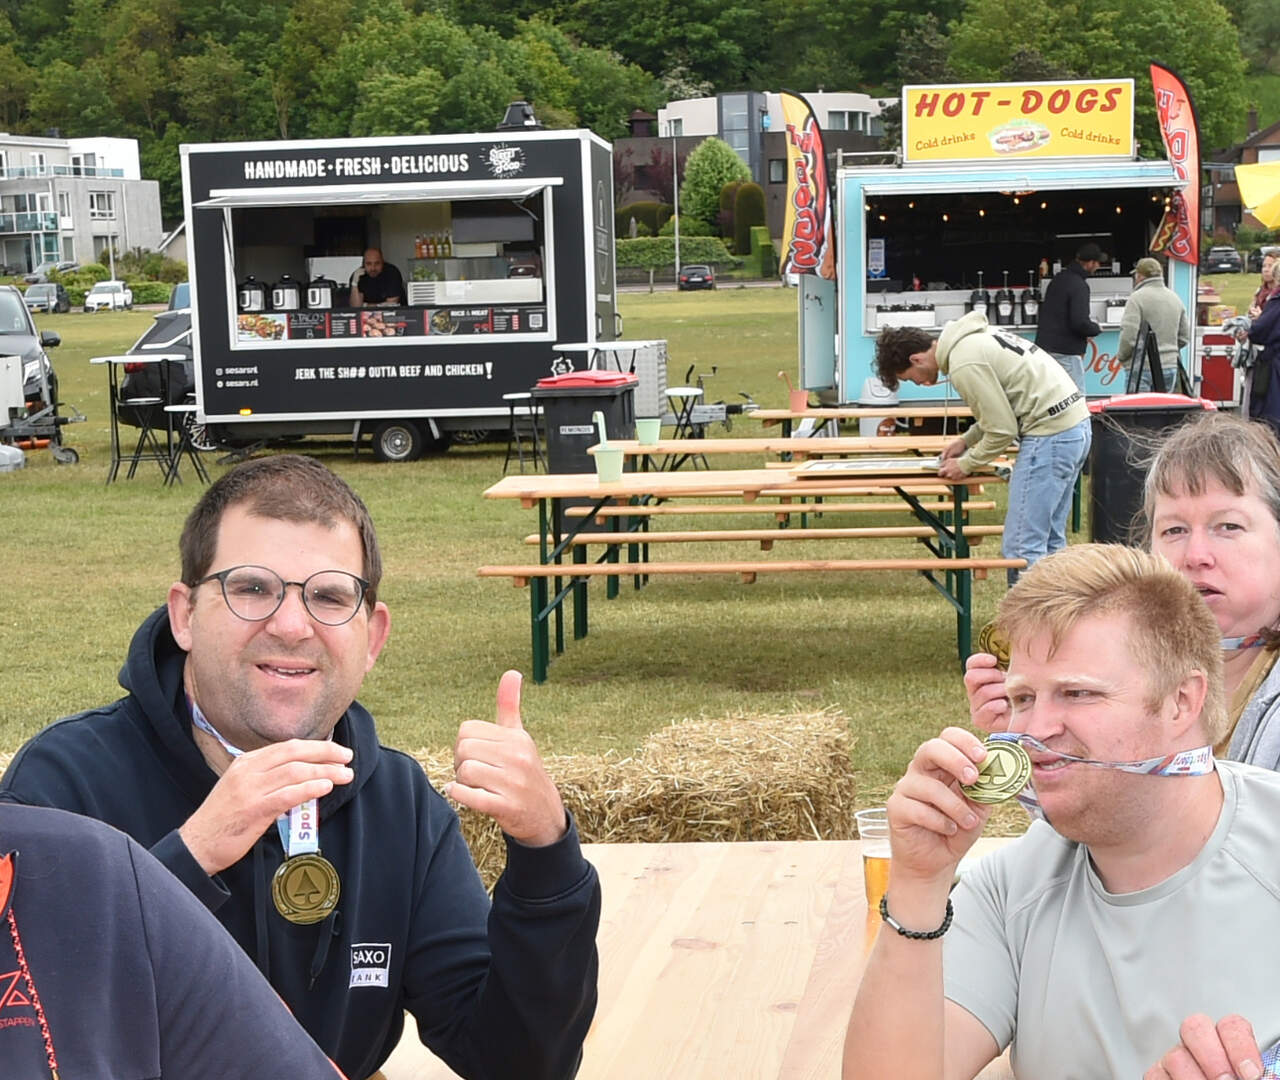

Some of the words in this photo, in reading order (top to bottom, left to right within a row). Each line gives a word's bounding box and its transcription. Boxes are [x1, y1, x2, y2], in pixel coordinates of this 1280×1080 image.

[915, 137, 938, 151] Cold
[940, 131, 976, 146] drinks
[1060, 127, 1083, 140] Cold
[1085, 129, 1121, 145] drinks
[244, 159, 327, 180] HANDMADE
[335, 156, 382, 176] FRESH
[391, 153, 470, 174] DELICIOUS
[294, 368, 316, 380] JERK
[318, 367, 335, 379] THE
[369, 366, 397, 378] OUTTA
[400, 365, 421, 377] BEEF
[424, 364, 443, 376] AND
[298, 803, 312, 840] Spor
[353, 950, 385, 964] SAXO
